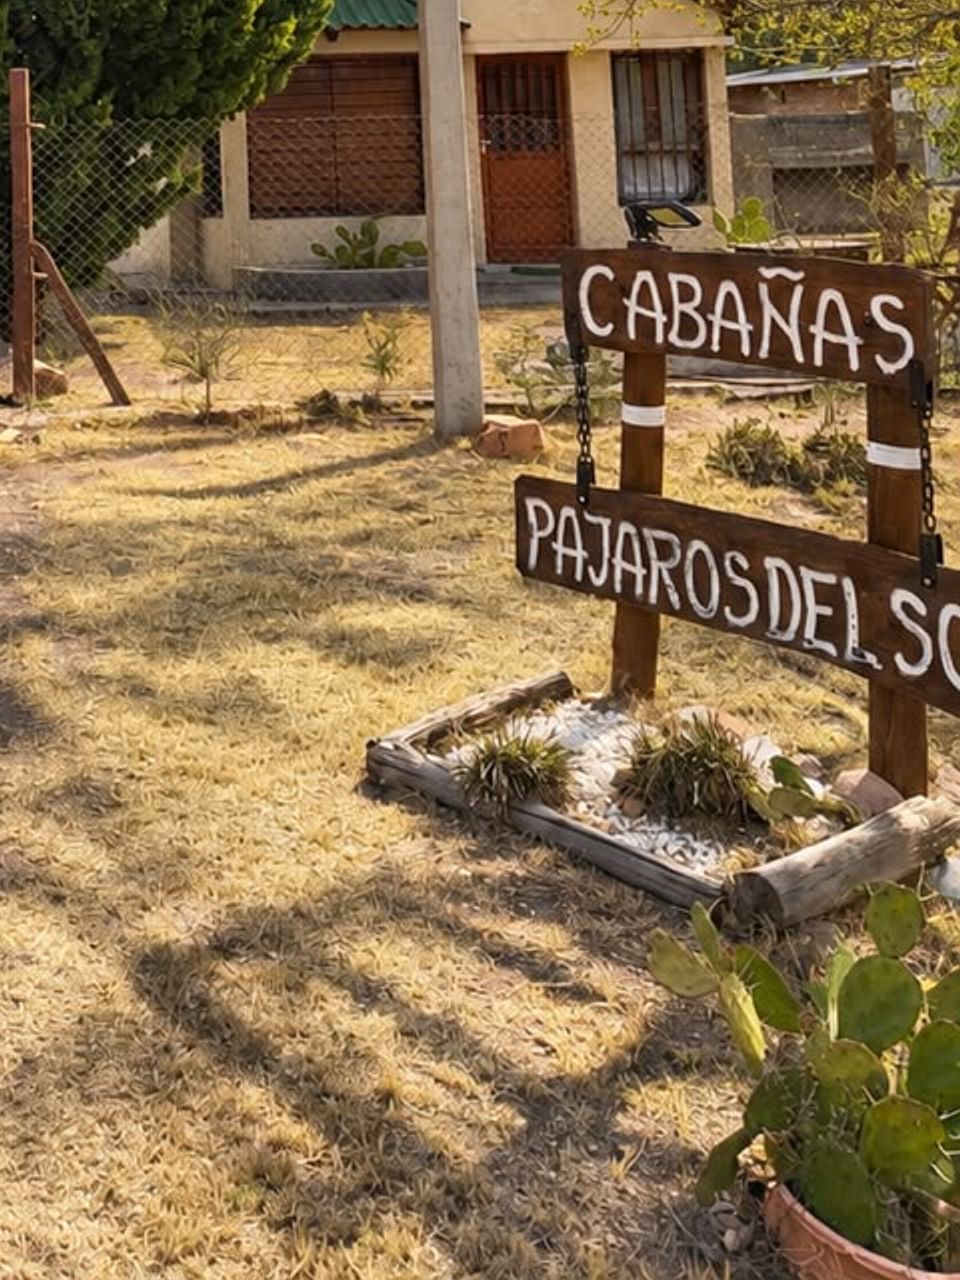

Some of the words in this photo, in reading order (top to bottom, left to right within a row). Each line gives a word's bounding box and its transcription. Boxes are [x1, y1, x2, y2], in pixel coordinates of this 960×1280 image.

[578, 264, 915, 375] CABAÑAS
[524, 496, 760, 627] PAJAROS
[763, 556, 883, 670] DEL
